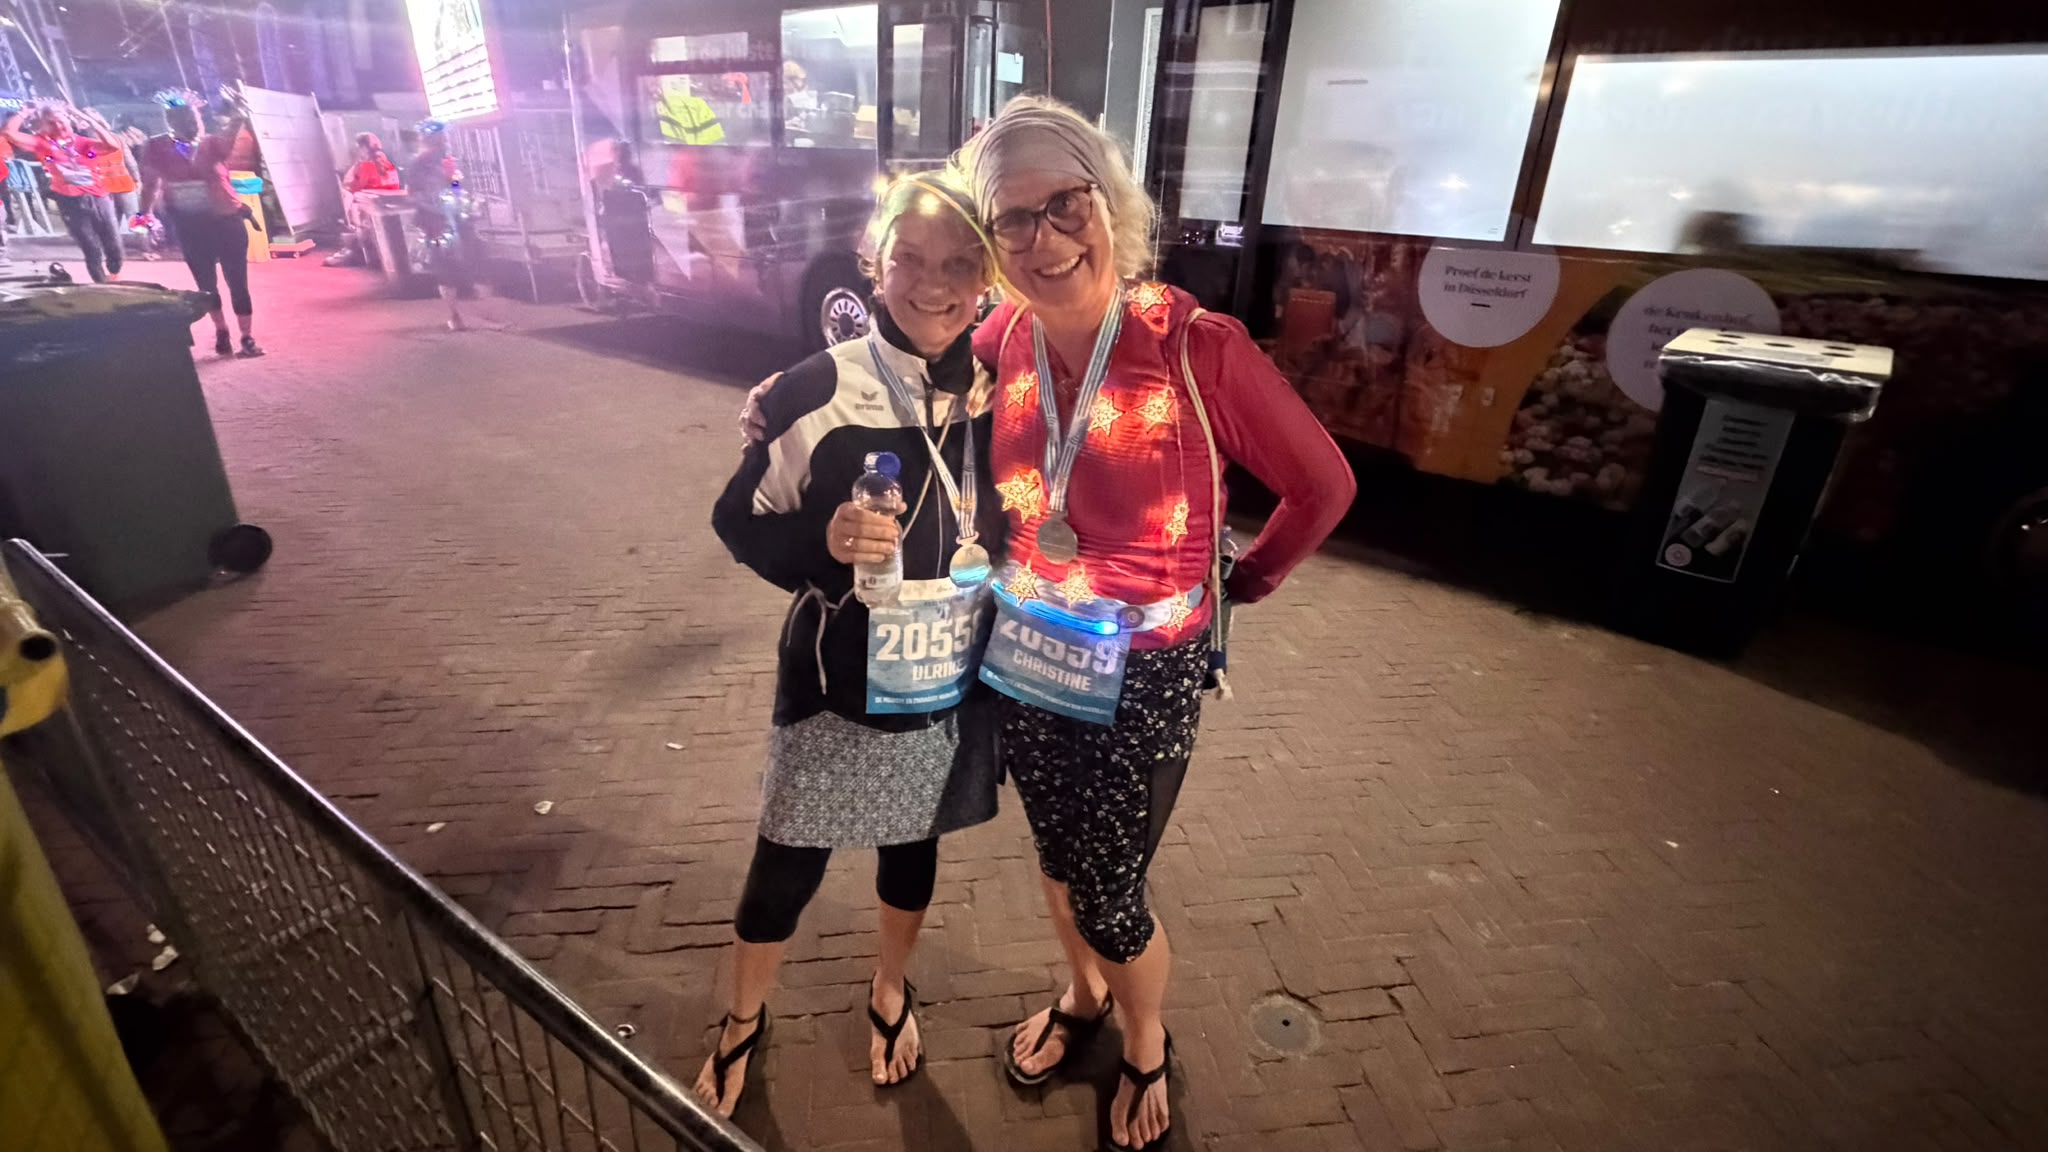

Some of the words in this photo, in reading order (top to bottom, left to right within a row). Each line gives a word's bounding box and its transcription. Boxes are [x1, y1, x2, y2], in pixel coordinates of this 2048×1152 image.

[1445, 265, 1479, 280] Proef
[1480, 269, 1497, 280] de
[1499, 270, 1532, 282] kerst
[1443, 283, 1456, 292] in
[1458, 283, 1529, 298] Düsseldorf
[1013, 649, 1092, 692] CHRISTINE
